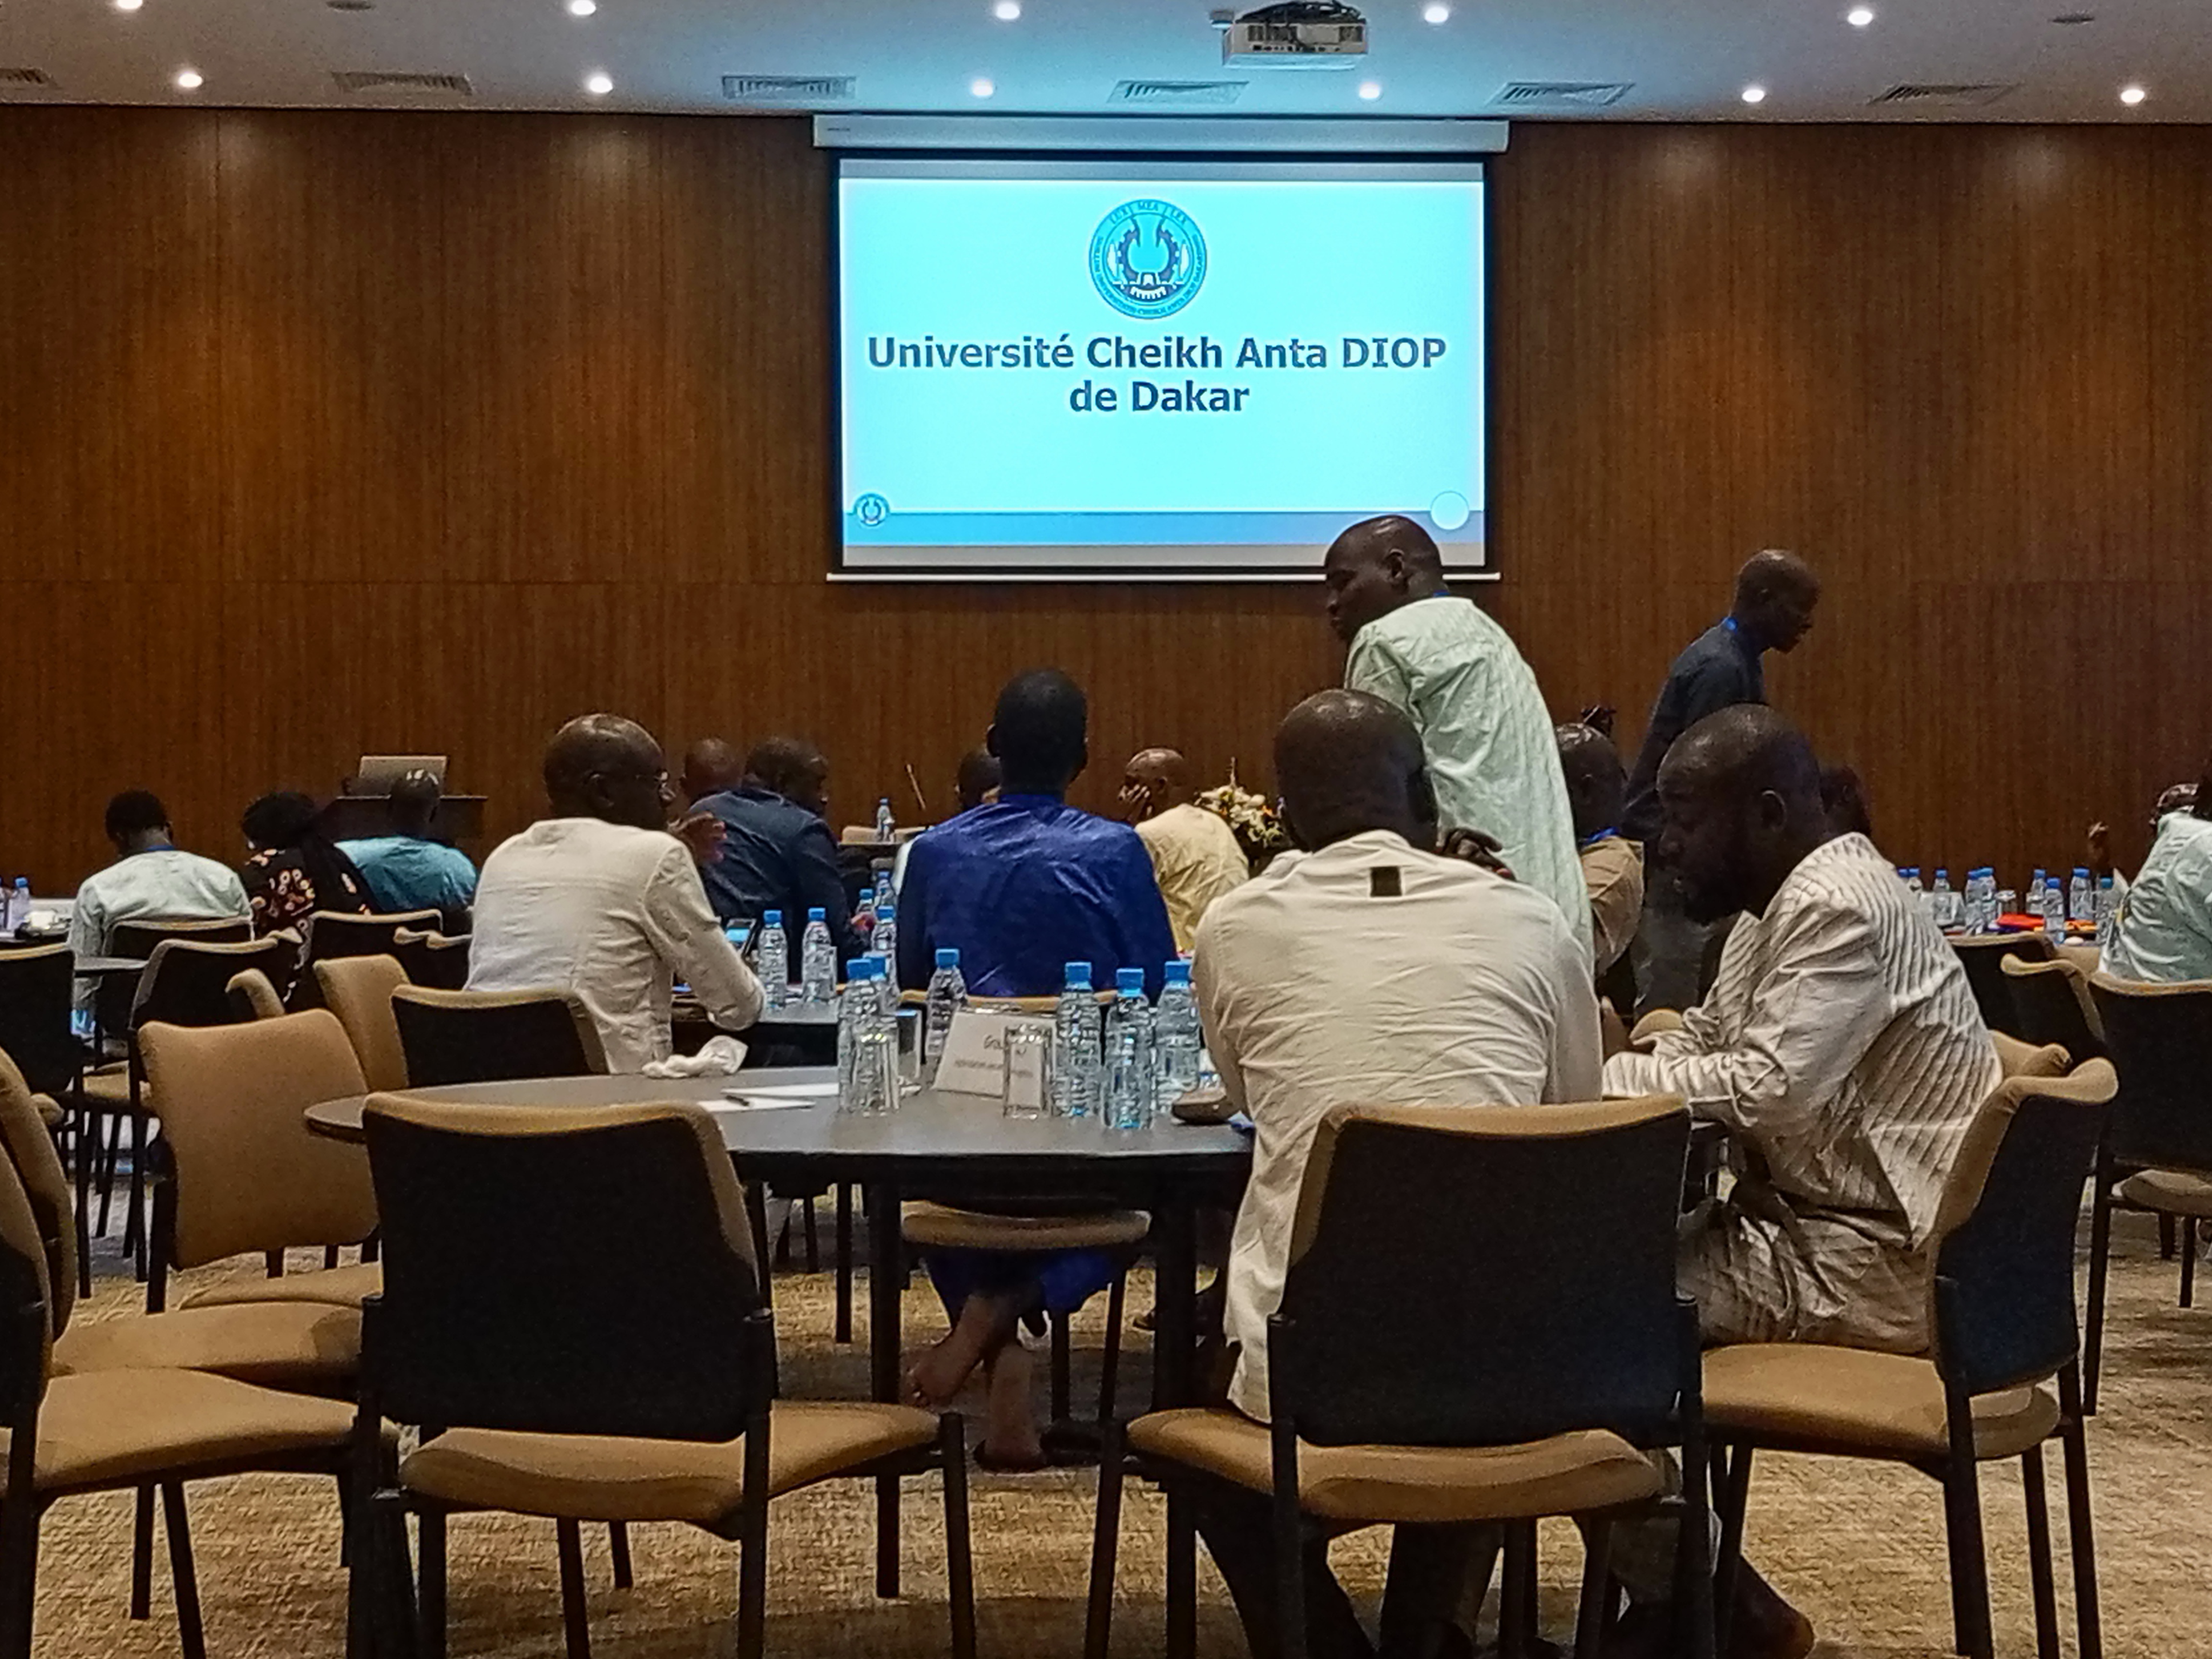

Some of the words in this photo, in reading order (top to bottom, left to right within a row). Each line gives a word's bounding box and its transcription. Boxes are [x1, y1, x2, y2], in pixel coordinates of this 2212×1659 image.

[869, 333, 1073, 368] Université
[1087, 336, 1222, 368] Cheikh
[1236, 337, 1326, 368] Anta
[1343, 337, 1445, 368] DIOP
[1070, 380, 1117, 412] de
[1132, 380, 1249, 412] Dakar
